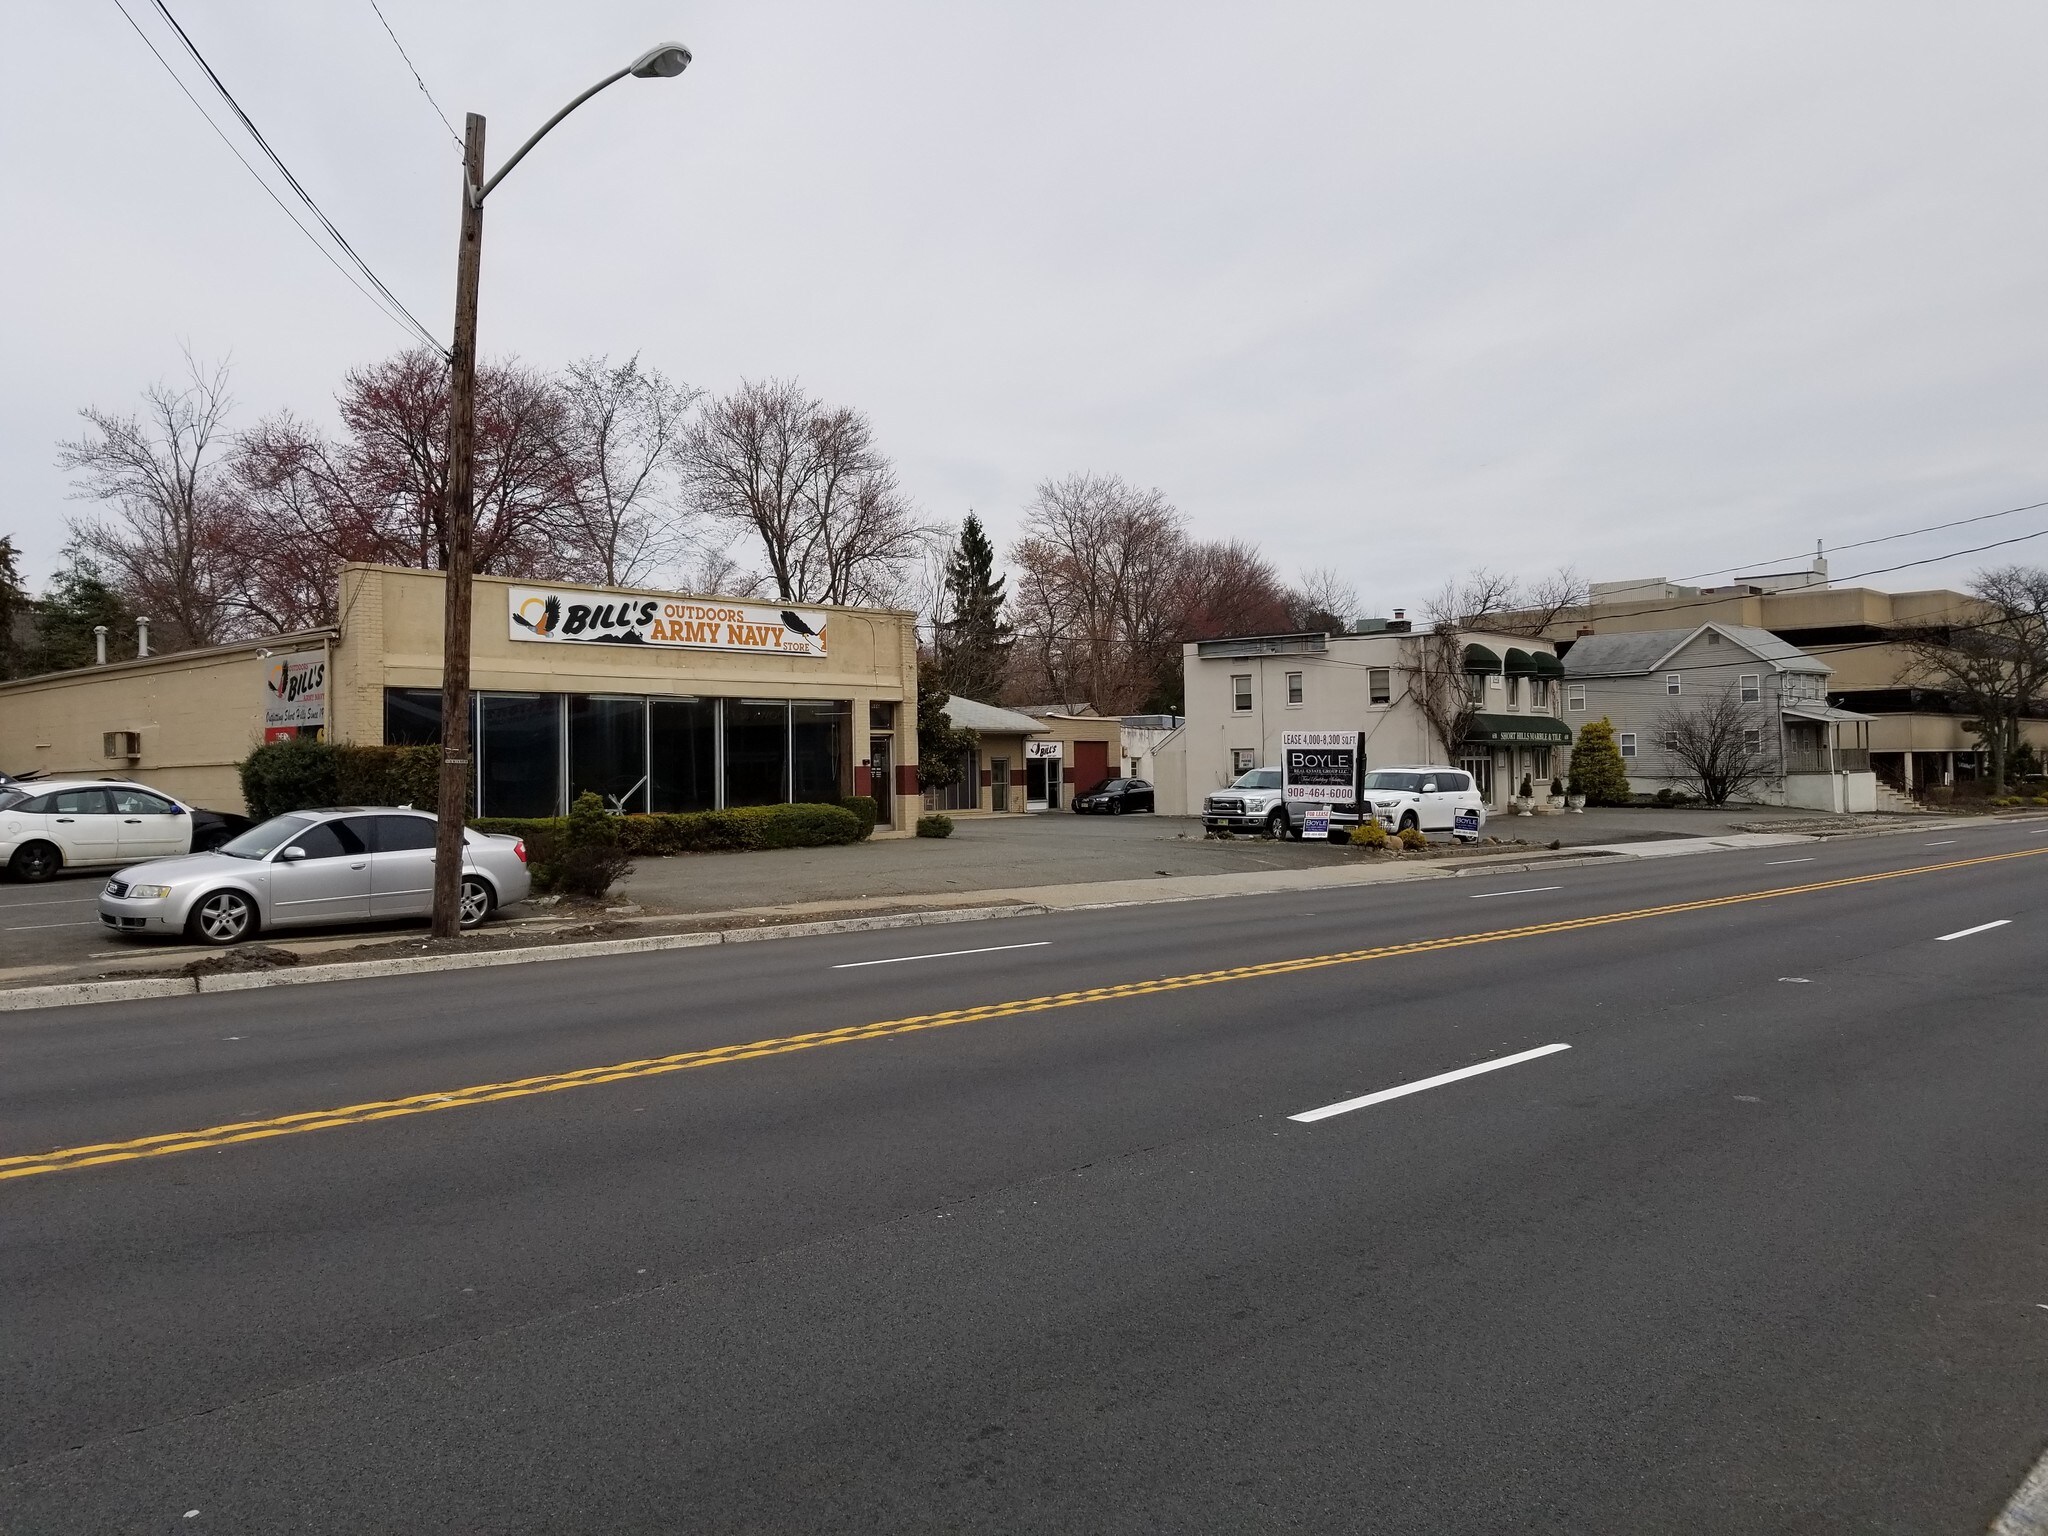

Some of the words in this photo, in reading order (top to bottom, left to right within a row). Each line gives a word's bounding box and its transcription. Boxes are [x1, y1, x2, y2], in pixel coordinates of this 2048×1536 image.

[562, 601, 658, 635] BILL'S
[664, 604, 744, 623] OUTDOORS
[651, 619, 721, 644] ARMY
[727, 624, 784, 647] NAVY
[783, 642, 810, 651] STORE
[288, 663, 325, 702] BILL'S
[1283, 734, 1302, 745] LEASE
[1303, 734, 1341, 746] 4,000-8,300
[1500, 731, 1516, 740] SHORT
[1517, 732, 1529, 740] HILLS
[1552, 733, 1562, 741] TILE
[1291, 752, 1349, 768] BOYLE
[1287, 787, 1353, 799] 908-464-6000
